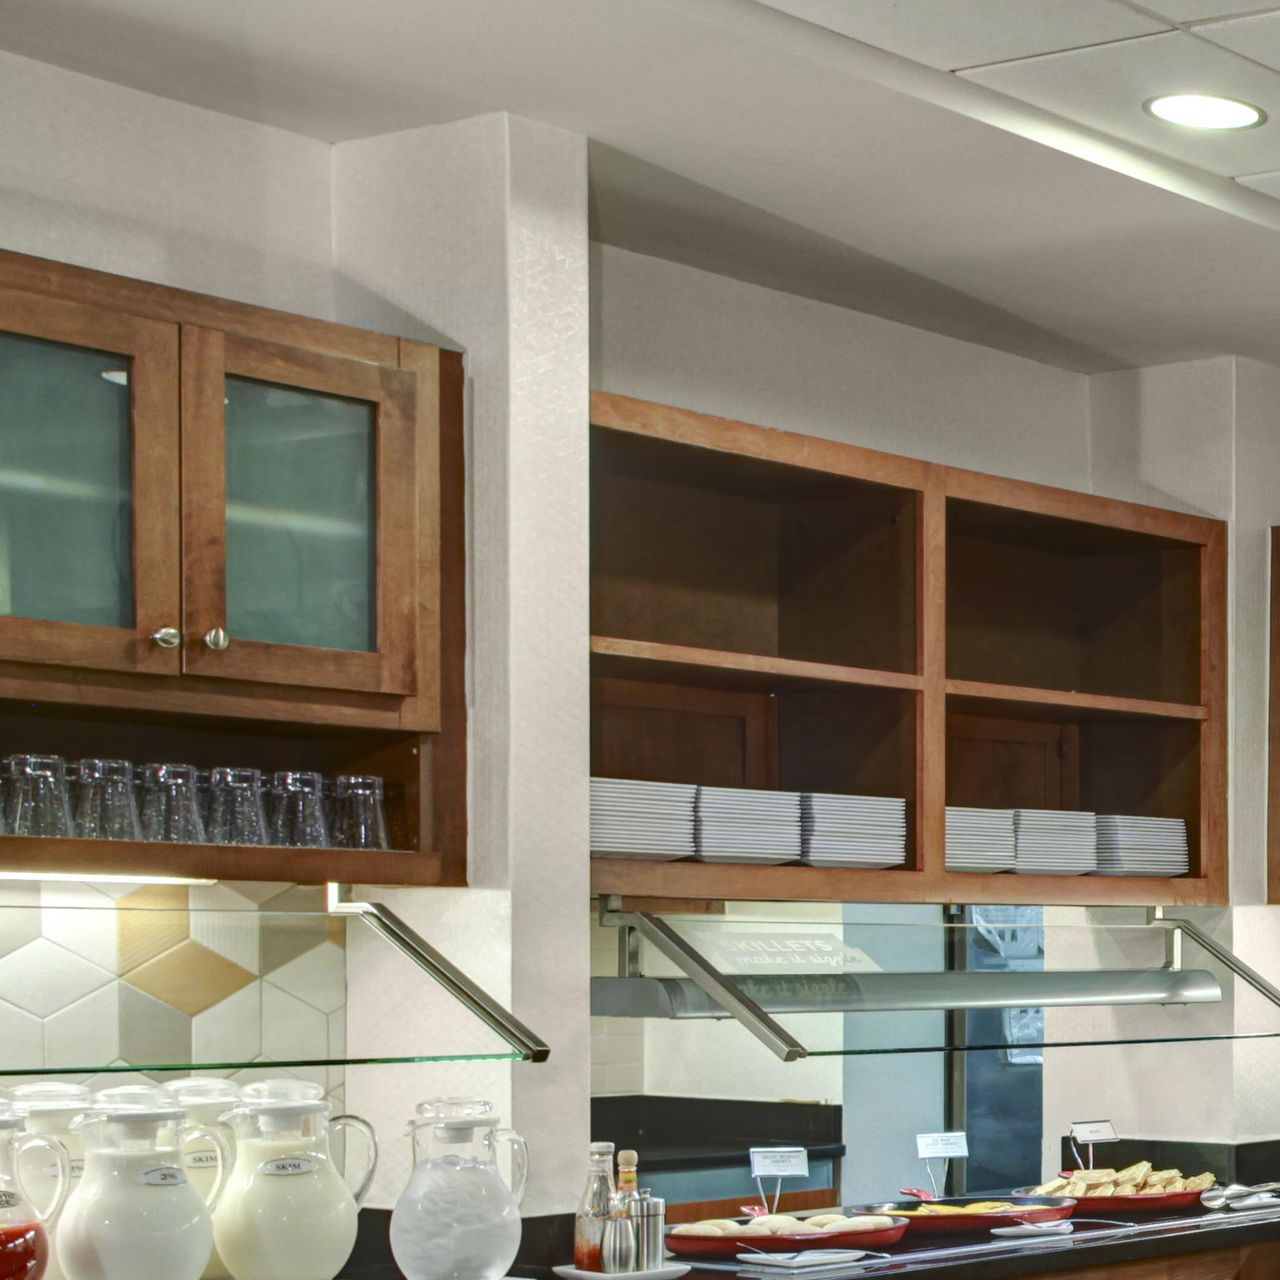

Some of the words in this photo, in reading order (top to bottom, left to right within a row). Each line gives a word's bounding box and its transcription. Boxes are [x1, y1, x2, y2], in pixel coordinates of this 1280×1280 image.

[720, 939, 833, 951] SKILLETS
[192, 1155, 217, 1164] SKIM
[275, 1163, 301, 1171] SKIM
[160, 1173, 177, 1181] 2%
